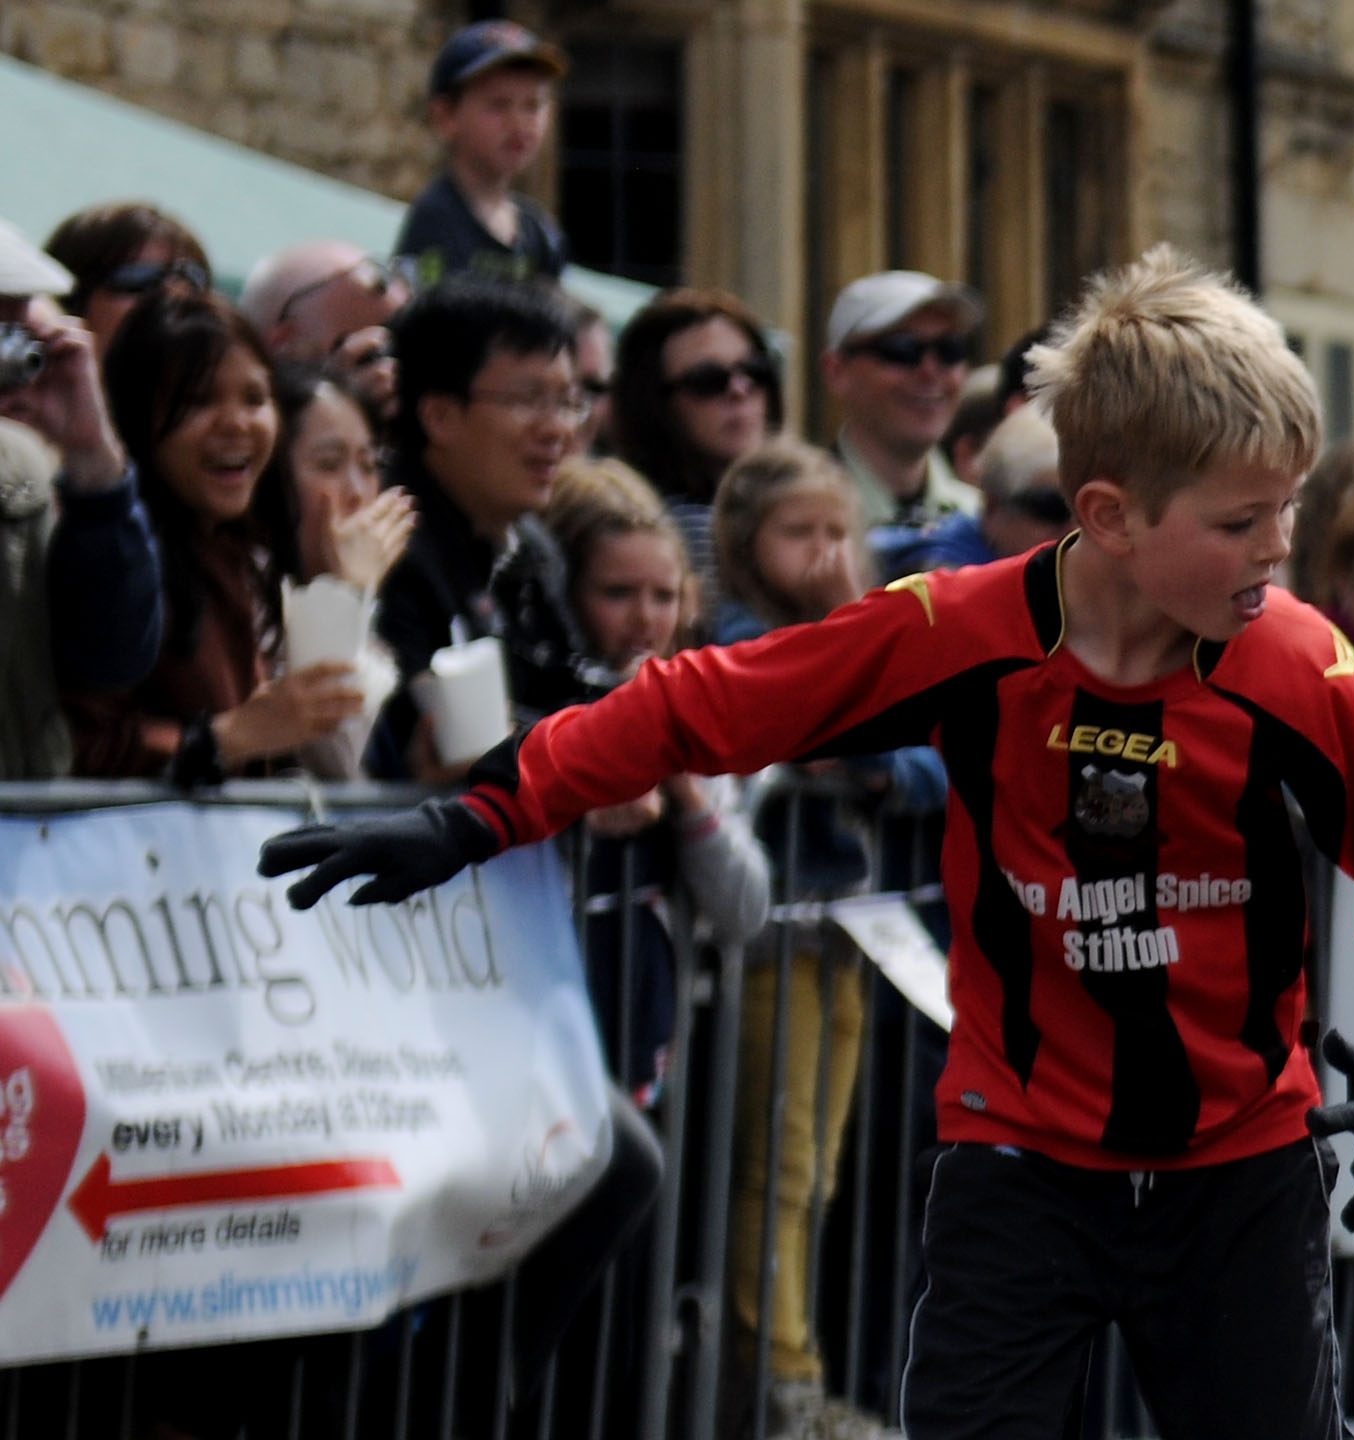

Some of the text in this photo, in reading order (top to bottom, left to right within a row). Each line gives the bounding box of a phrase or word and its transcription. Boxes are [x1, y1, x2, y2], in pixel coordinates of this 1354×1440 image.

[1046, 724, 1179, 768] LEGEA
[1057, 873, 1146, 925] Angel
[1156, 873, 1252, 912] Spice
[1063, 925, 1180, 972] Stilton
[112, 1116, 204, 1154] every
[101, 1209, 302, 1262] for more details
